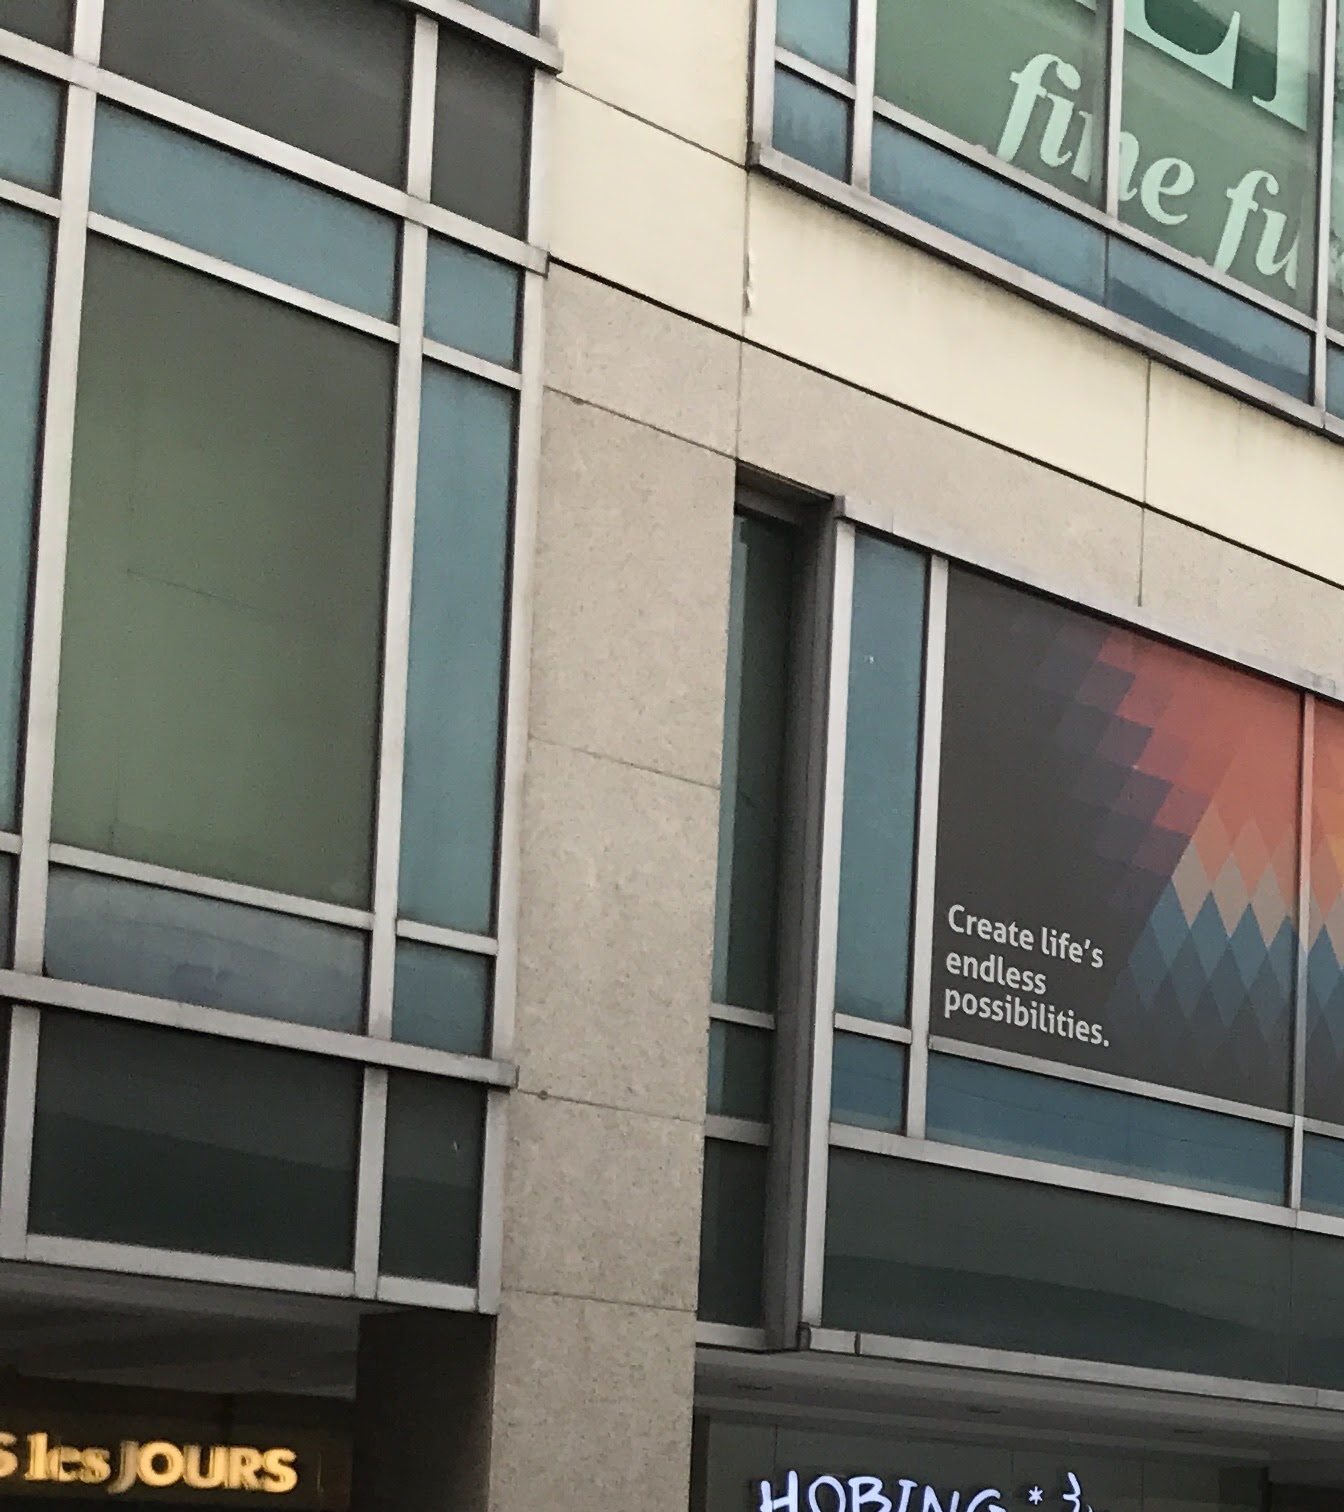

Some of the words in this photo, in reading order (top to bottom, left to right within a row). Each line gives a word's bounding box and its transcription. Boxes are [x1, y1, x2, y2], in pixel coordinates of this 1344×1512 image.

[997, 54, 1194, 225] fine
[948, 904, 1034, 951] Create
[1041, 926, 1104, 968] life's
[946, 951, 1047, 995] endless
[944, 987, 1110, 1048] possibilities.
[25, 1432, 110, 1484] les
[108, 1440, 298, 1494] JOURS
